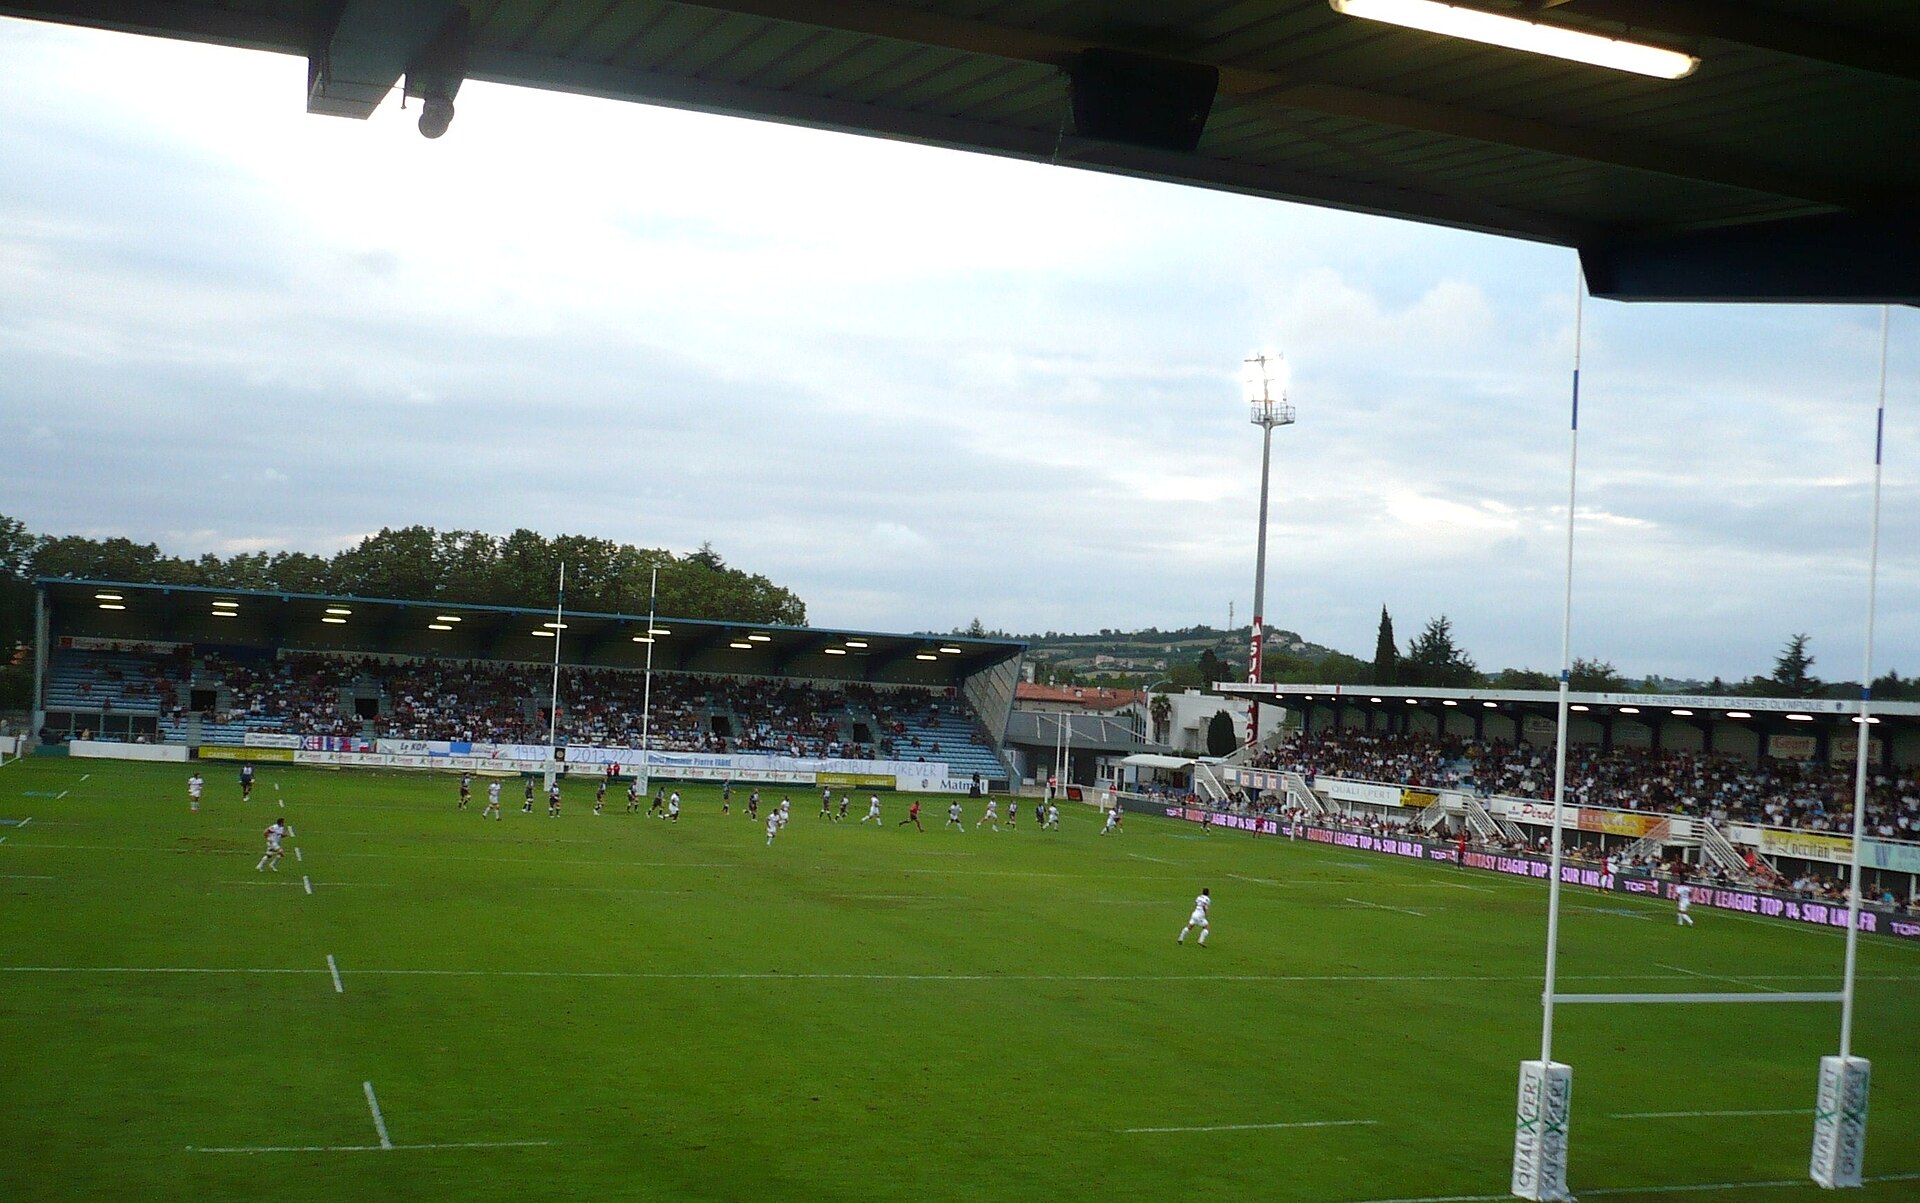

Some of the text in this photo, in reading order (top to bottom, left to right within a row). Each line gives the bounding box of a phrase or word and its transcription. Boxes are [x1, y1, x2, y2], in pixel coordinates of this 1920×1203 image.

[940, 779, 986, 792] Matmt
[1359, 835, 1373, 849] TOP
[1382, 839, 1397, 854] SUR
[1497, 856, 1530, 877] LEAGUE
[1531, 862, 1548, 879] TOP
[1560, 868, 1580, 883] SUR
[1714, 889, 1758, 913] LEAGUE
[1759, 896, 1783, 917] TOP
[1801, 902, 1828, 924] SUR
[1829, 907, 1877, 932] LN.FR
[1518, 1071, 1542, 1188] QUALIXPERT
